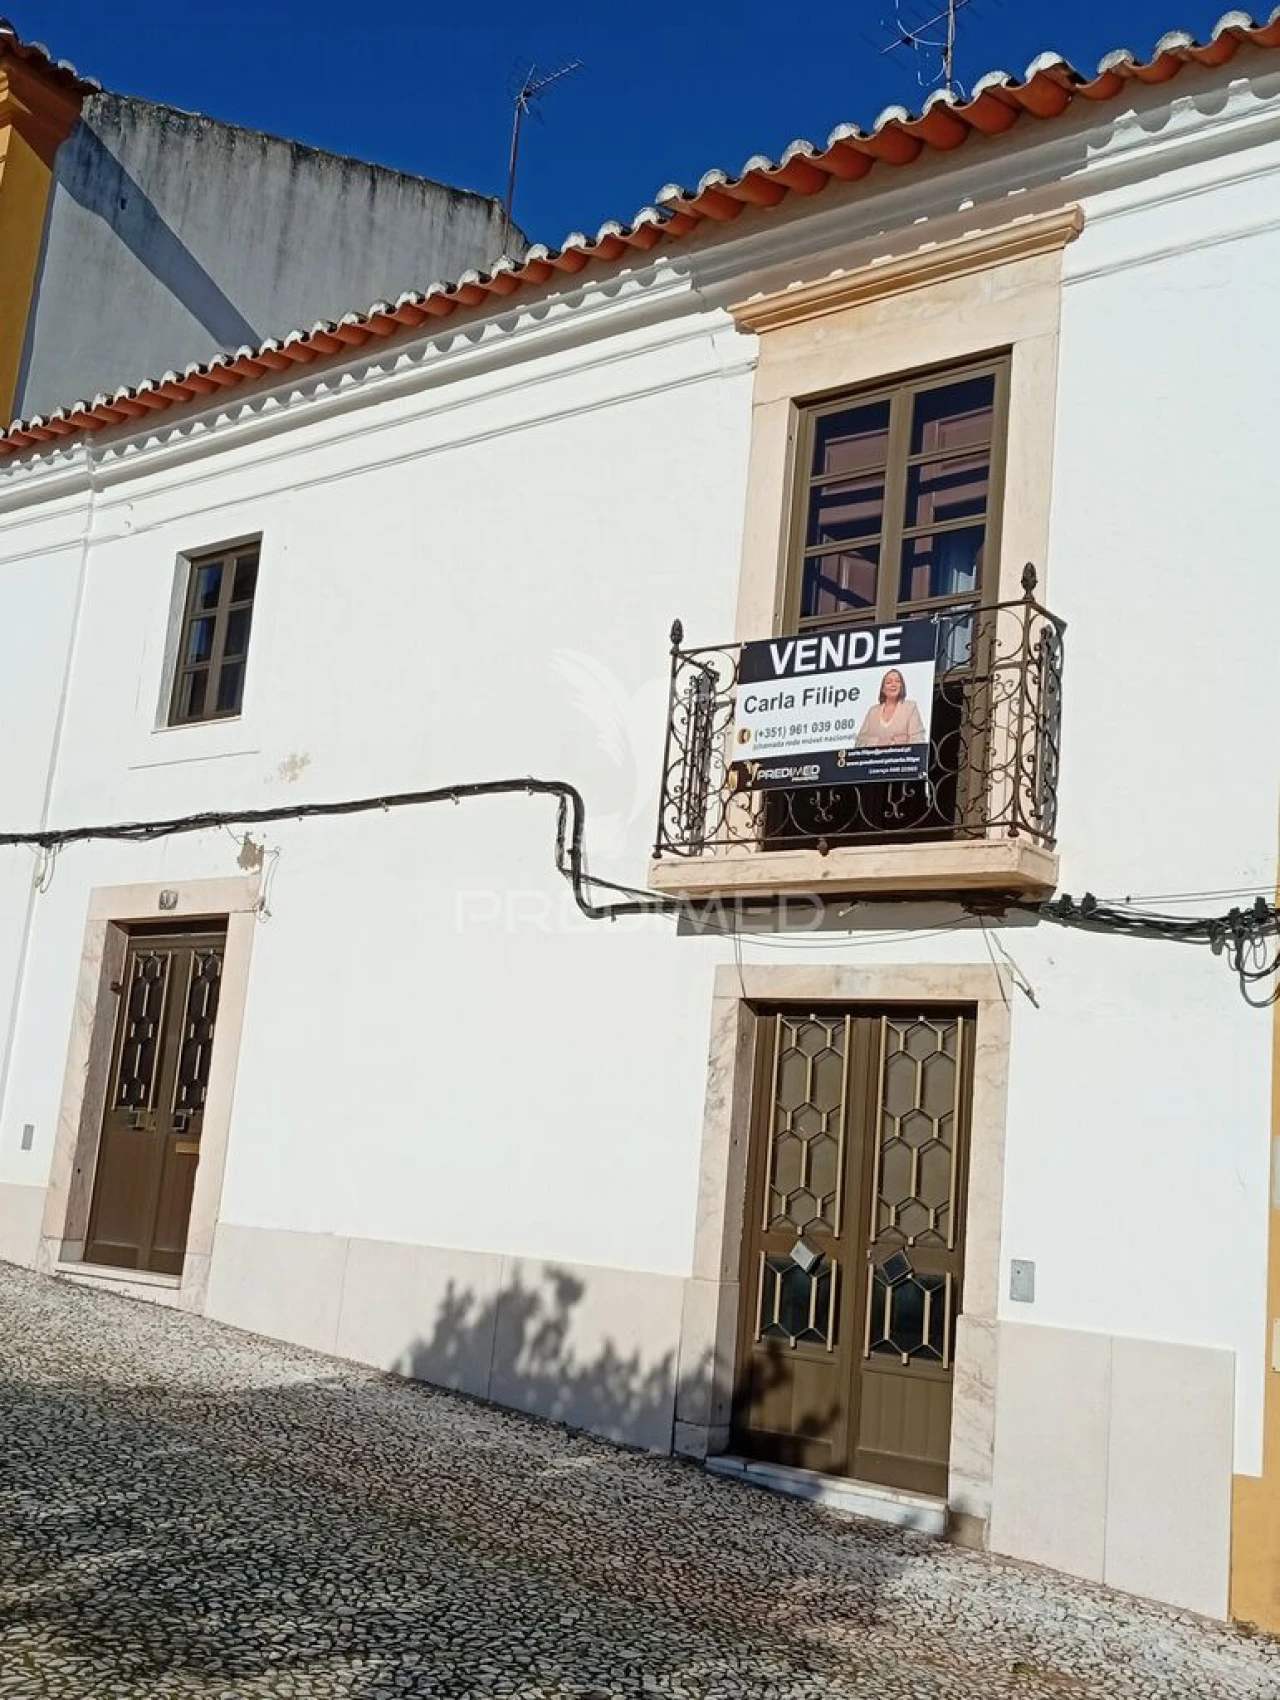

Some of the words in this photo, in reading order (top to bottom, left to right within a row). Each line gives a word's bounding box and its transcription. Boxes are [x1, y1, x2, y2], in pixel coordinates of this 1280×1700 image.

[769, 625, 903, 675] VENDE
[744, 691, 795, 714] Carla
[802, 686, 861, 709] Filipe
[754, 725, 788, 743] (+351)
[789, 723, 809, 737] 961
[811, 720, 831, 734] 039
[834, 717, 856, 731] 080
[757, 764, 820, 781] PREDIMED
